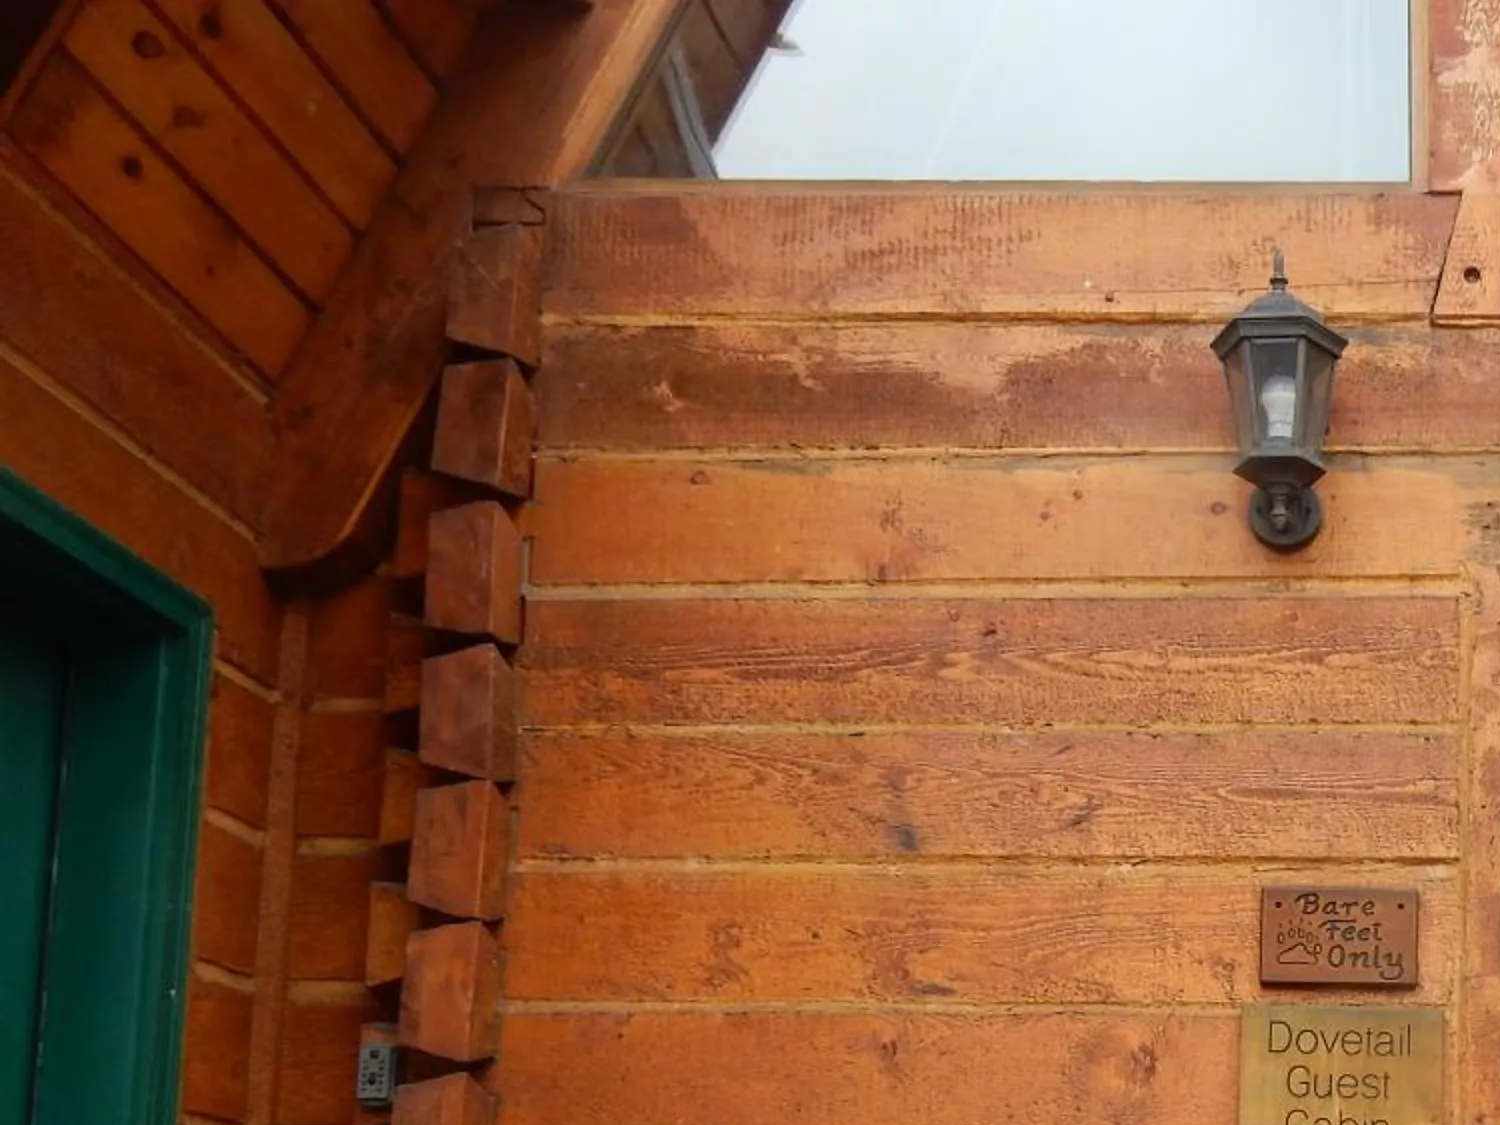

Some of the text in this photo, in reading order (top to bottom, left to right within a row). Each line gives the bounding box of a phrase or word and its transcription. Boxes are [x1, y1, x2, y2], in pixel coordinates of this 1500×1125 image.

[1295, 892, 1375, 916] Bare
[1318, 919, 1383, 942] Feet
[1326, 944, 1405, 980] Only
[1268, 1021, 1412, 1056] Dovetail
[1287, 1065, 1391, 1100] Guest
